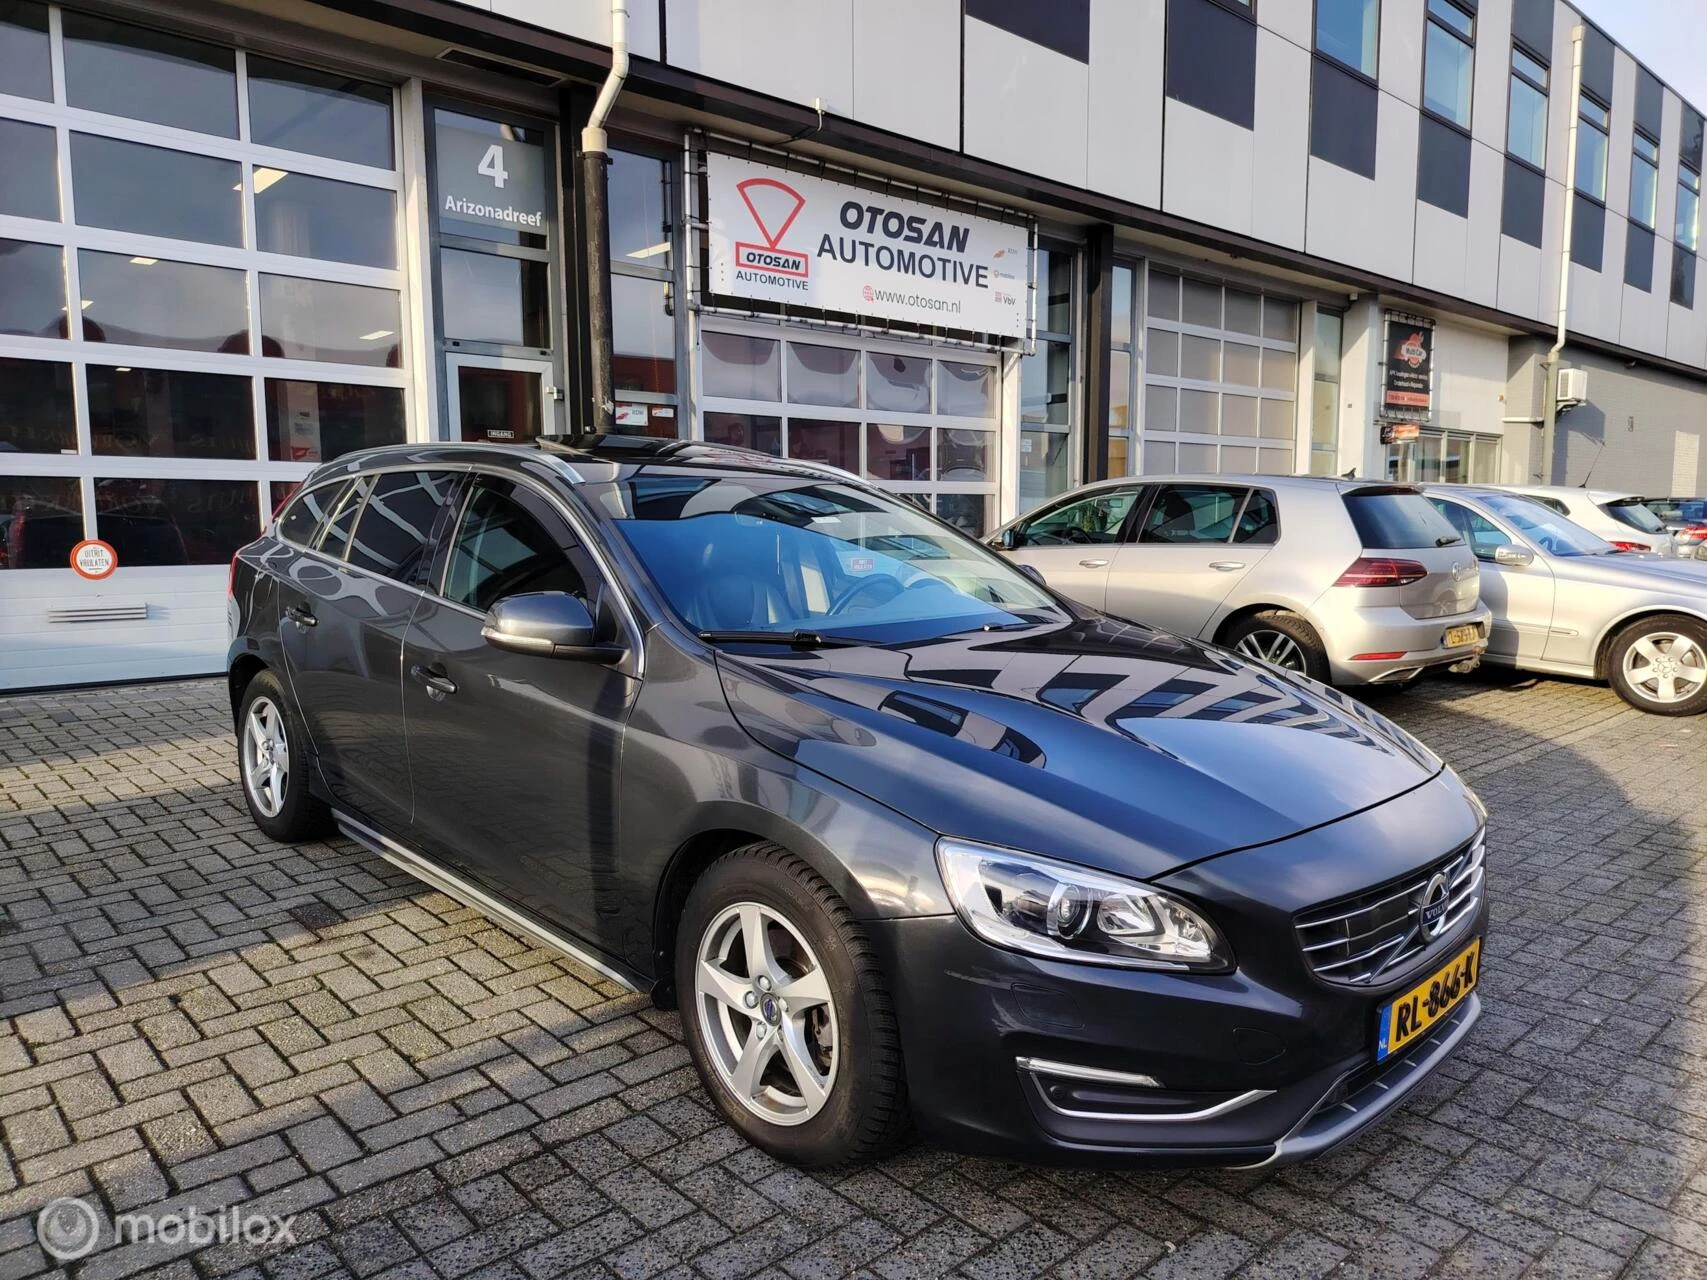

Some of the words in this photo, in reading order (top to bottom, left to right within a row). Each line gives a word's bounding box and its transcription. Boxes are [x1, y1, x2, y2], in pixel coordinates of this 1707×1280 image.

[477, 144, 508, 189] 4
[445, 195, 542, 227] Arizonadreef
[840, 201, 970, 253] OTOSAN
[746, 252, 801, 271] OTOSAN
[817, 233, 989, 289] AUTOMOTIVE
[736, 271, 809, 291] AUTOMOTIVE
[875, 288, 961, 313] www.otosan.nl
[84, 549, 104, 558] UITRIT
[1395, 951, 1474, 1043] RL-866-K
